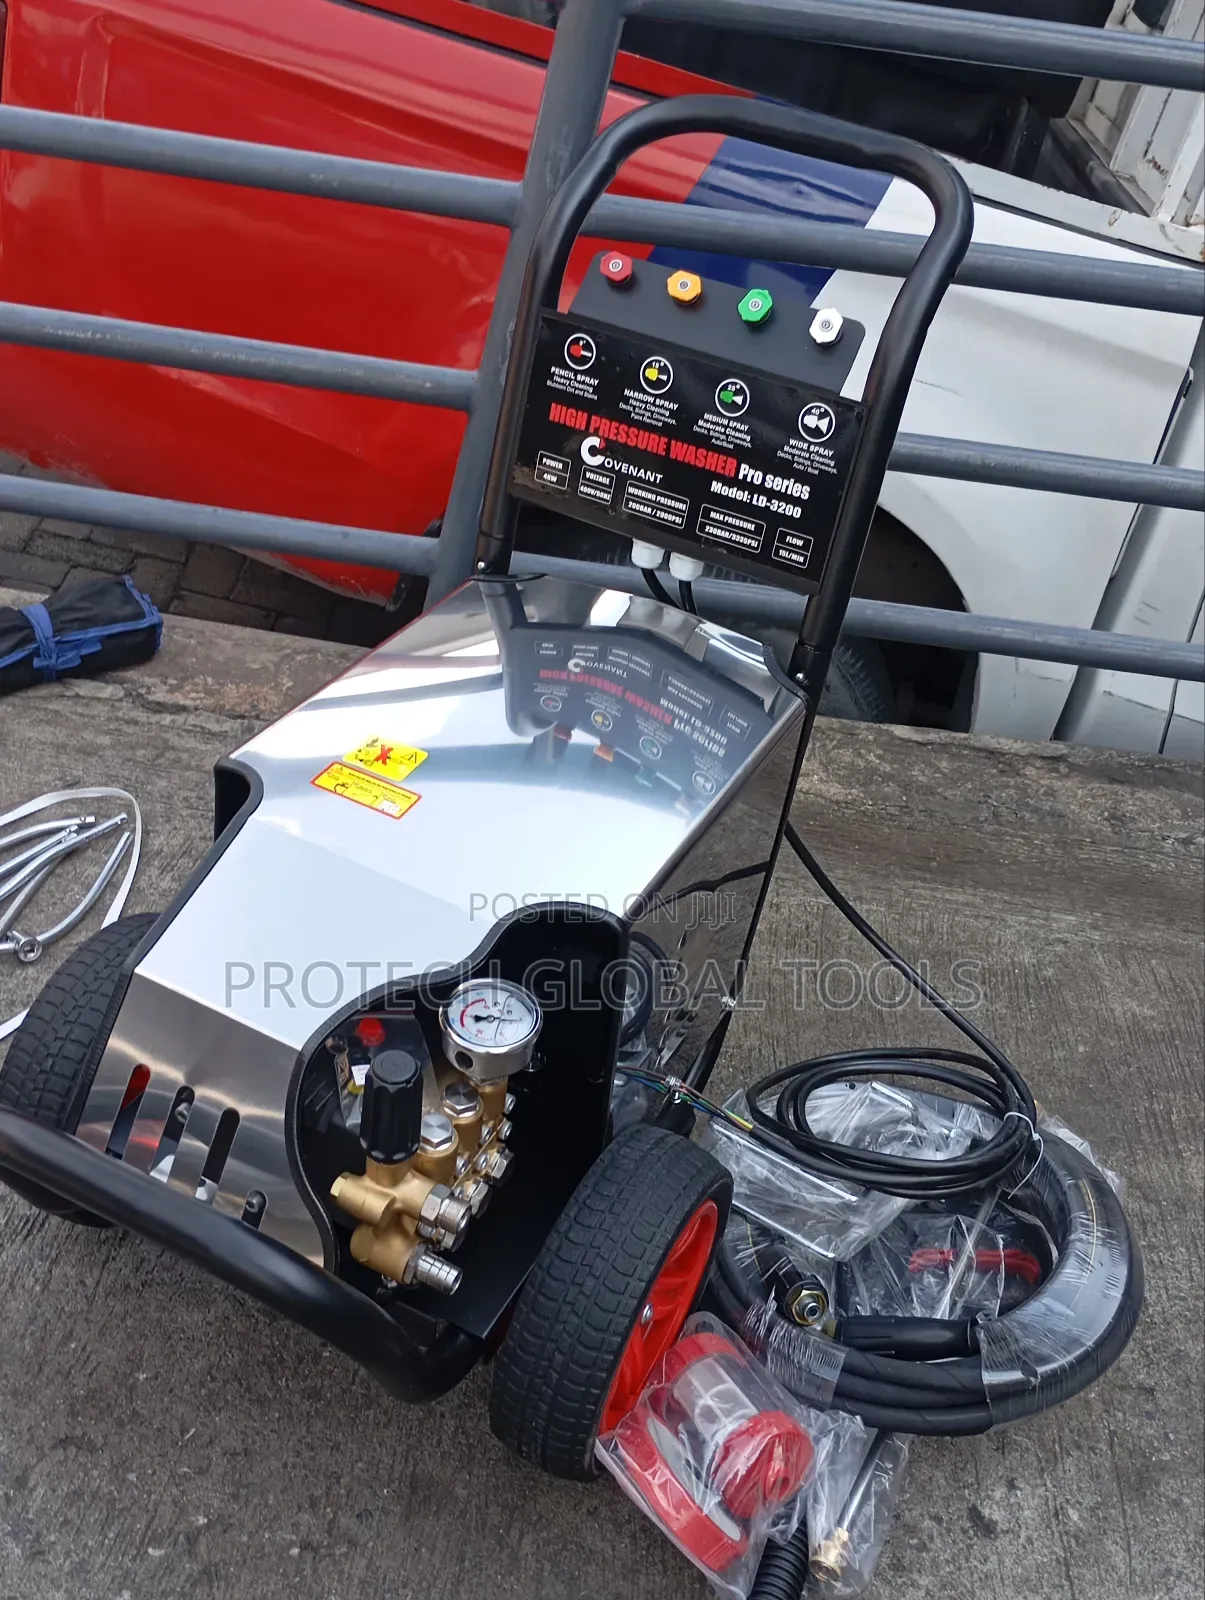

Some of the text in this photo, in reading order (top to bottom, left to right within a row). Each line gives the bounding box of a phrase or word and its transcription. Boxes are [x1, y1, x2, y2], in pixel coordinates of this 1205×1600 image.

[551, 366, 599, 386] PENCIL SPRAY
[553, 375, 594, 393] Heavy Cleaning
[624, 388, 679, 411] NARROW SPRAY
[629, 398, 670, 417] Heavy Cleaning
[697, 419, 751, 442] Moderate Cleaning
[703, 412, 749, 432] MEDIUM SPRAY
[549, 402, 811, 500] HIGH PRESSURE WASHER Pro series
[783, 445, 836, 468] Moderate Cleaning
[789, 438, 834, 458] WIDE SPRAY
[542, 457, 563, 470] POWER
[580, 436, 663, 484] COVENANT
[793, 462, 804, 471] Auto
[542, 472, 558, 483] 4KW
[585, 471, 610, 485] VOLTAGE
[628, 485, 687, 511] WORKING PRESSURE
[710, 480, 802, 519] Model: LD-3200
[709, 511, 755, 531] MAX PRESSURE
[785, 535, 804, 547] FLOW
[779, 549, 804, 563] 15L/MIN
